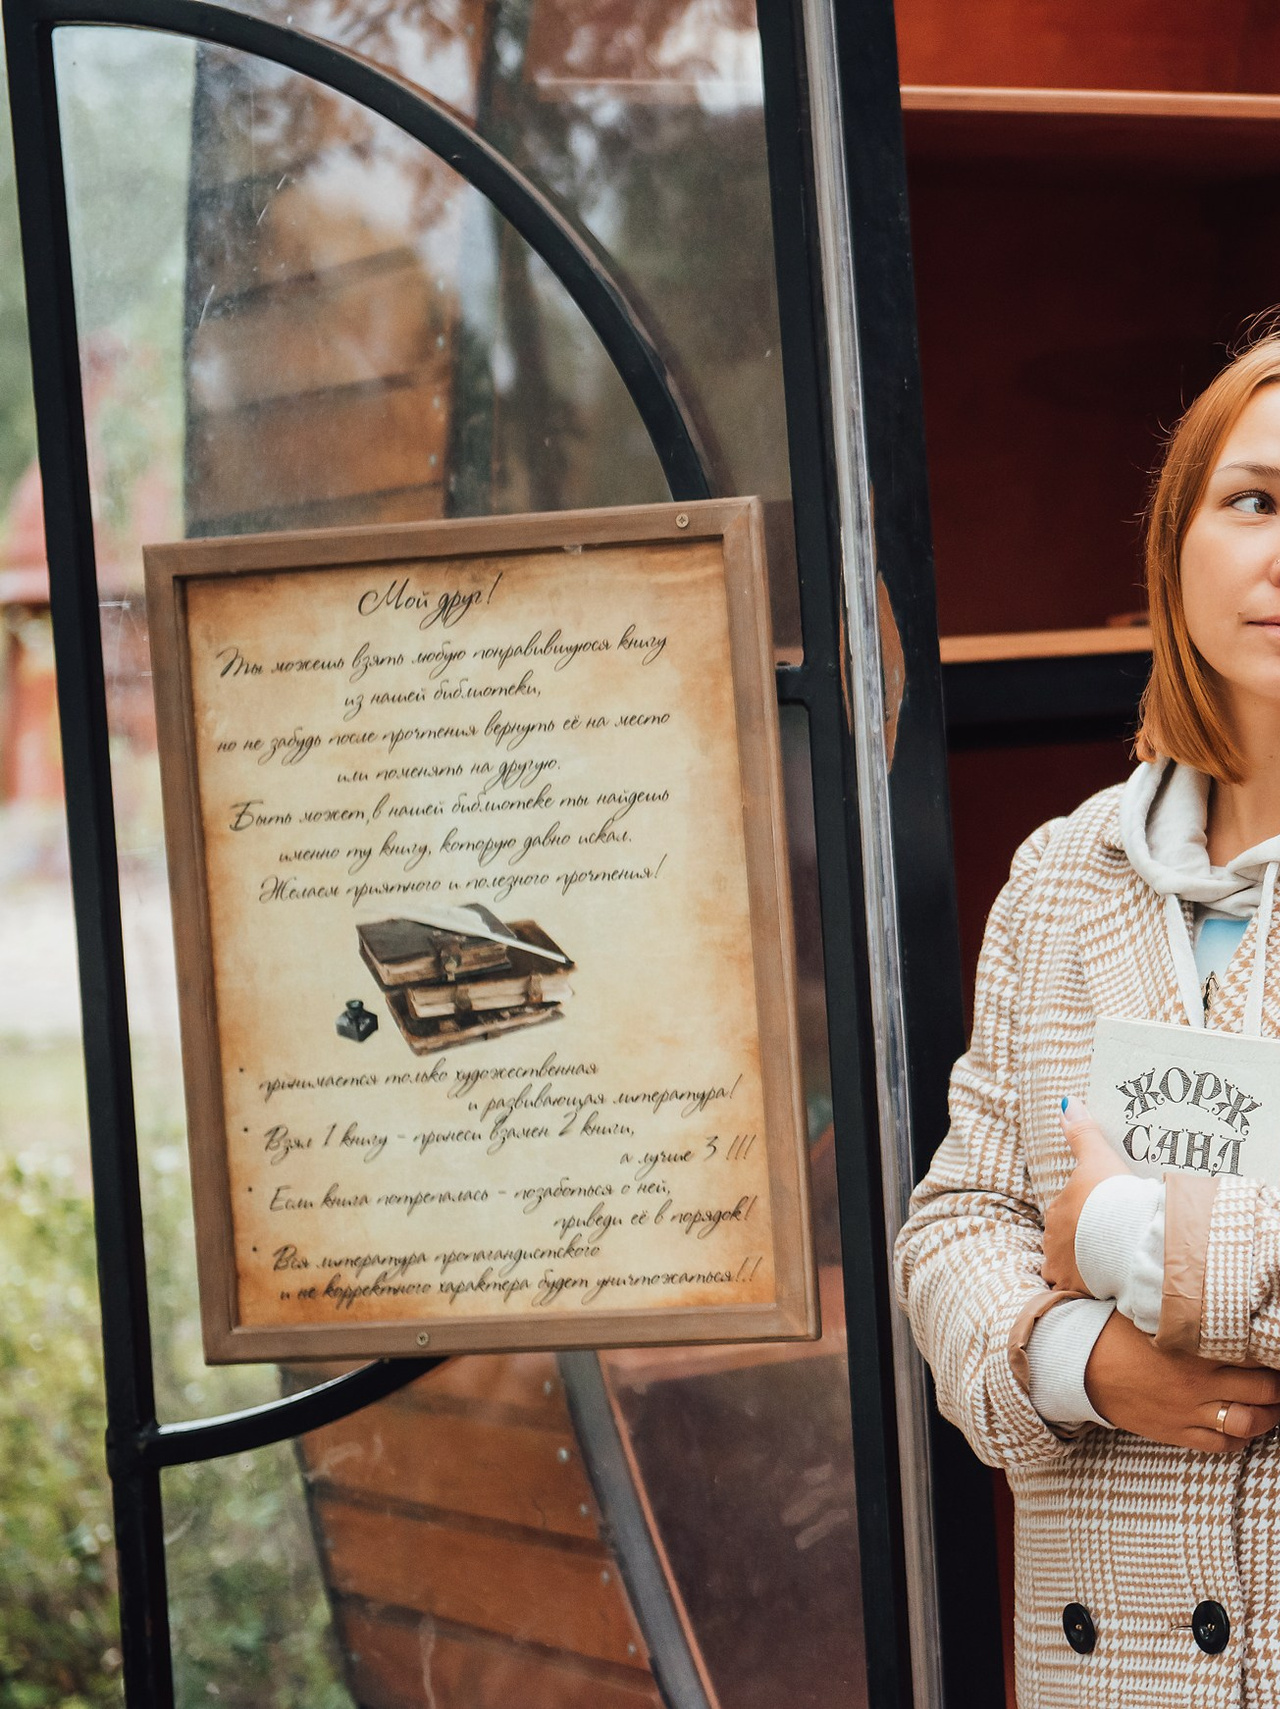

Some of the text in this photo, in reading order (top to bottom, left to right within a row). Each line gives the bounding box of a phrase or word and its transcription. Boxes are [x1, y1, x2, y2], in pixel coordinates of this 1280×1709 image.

[358, 572, 503, 630] Мой друг!
[216, 647, 263, 678] Ты
[271, 658, 345, 674] можешь
[350, 642, 404, 683] взять
[411, 641, 466, 680] любую
[617, 624, 668, 666] книгу
[343, 669, 541, 722] из нашей библиотеки,
[217, 710, 670, 766] но не забудь после прочтения вернуть её на место
[337, 772, 369, 783] или
[375, 765, 463, 780] поменять
[470, 764, 493, 774] на
[229, 799, 292, 831] Быть
[388, 801, 444, 817] нашей
[452, 783, 554, 813] библиотеке
[559, 796, 589, 807] ты
[279, 850, 340, 862] именно
[346, 848, 372, 875] ту
[440, 828, 517, 867] которую
[509, 821, 571, 865] давно
[578, 817, 632, 843] искал.
[259, 875, 339, 903] Желаем
[346, 879, 441, 908] приятного
[466, 875, 550, 902] полезного
[556, 854, 667, 896] прочтения!
[259, 1051, 600, 1103] принимается только художественная
[480, 1083, 605, 1122] развивающая
[613, 1074, 743, 1118] литература!
[1115, 1066, 1263, 1136] ЖОРЖ
[263, 1124, 312, 1166] Взял
[323, 1123, 337, 1147] 1
[340, 1121, 388, 1163] книгу
[413, 1130, 482, 1155] принеси
[487, 1114, 550, 1155] взамен
[558, 1111, 578, 1137] 2
[620, 1152, 631, 1164] а
[634, 1150, 694, 1180] лучше
[703, 1135, 718, 1161] 3
[1122, 1121, 1247, 1178] САНД
[269, 1185, 313, 1212] Если
[320, 1183, 370, 1209] книга
[554, 1195, 758, 1243] приведи её в порядок!
[272, 1233, 600, 1281] Вся литература пропагандистского
[439, 1267, 530, 1305] характера
[532, 1269, 589, 1307] будет
